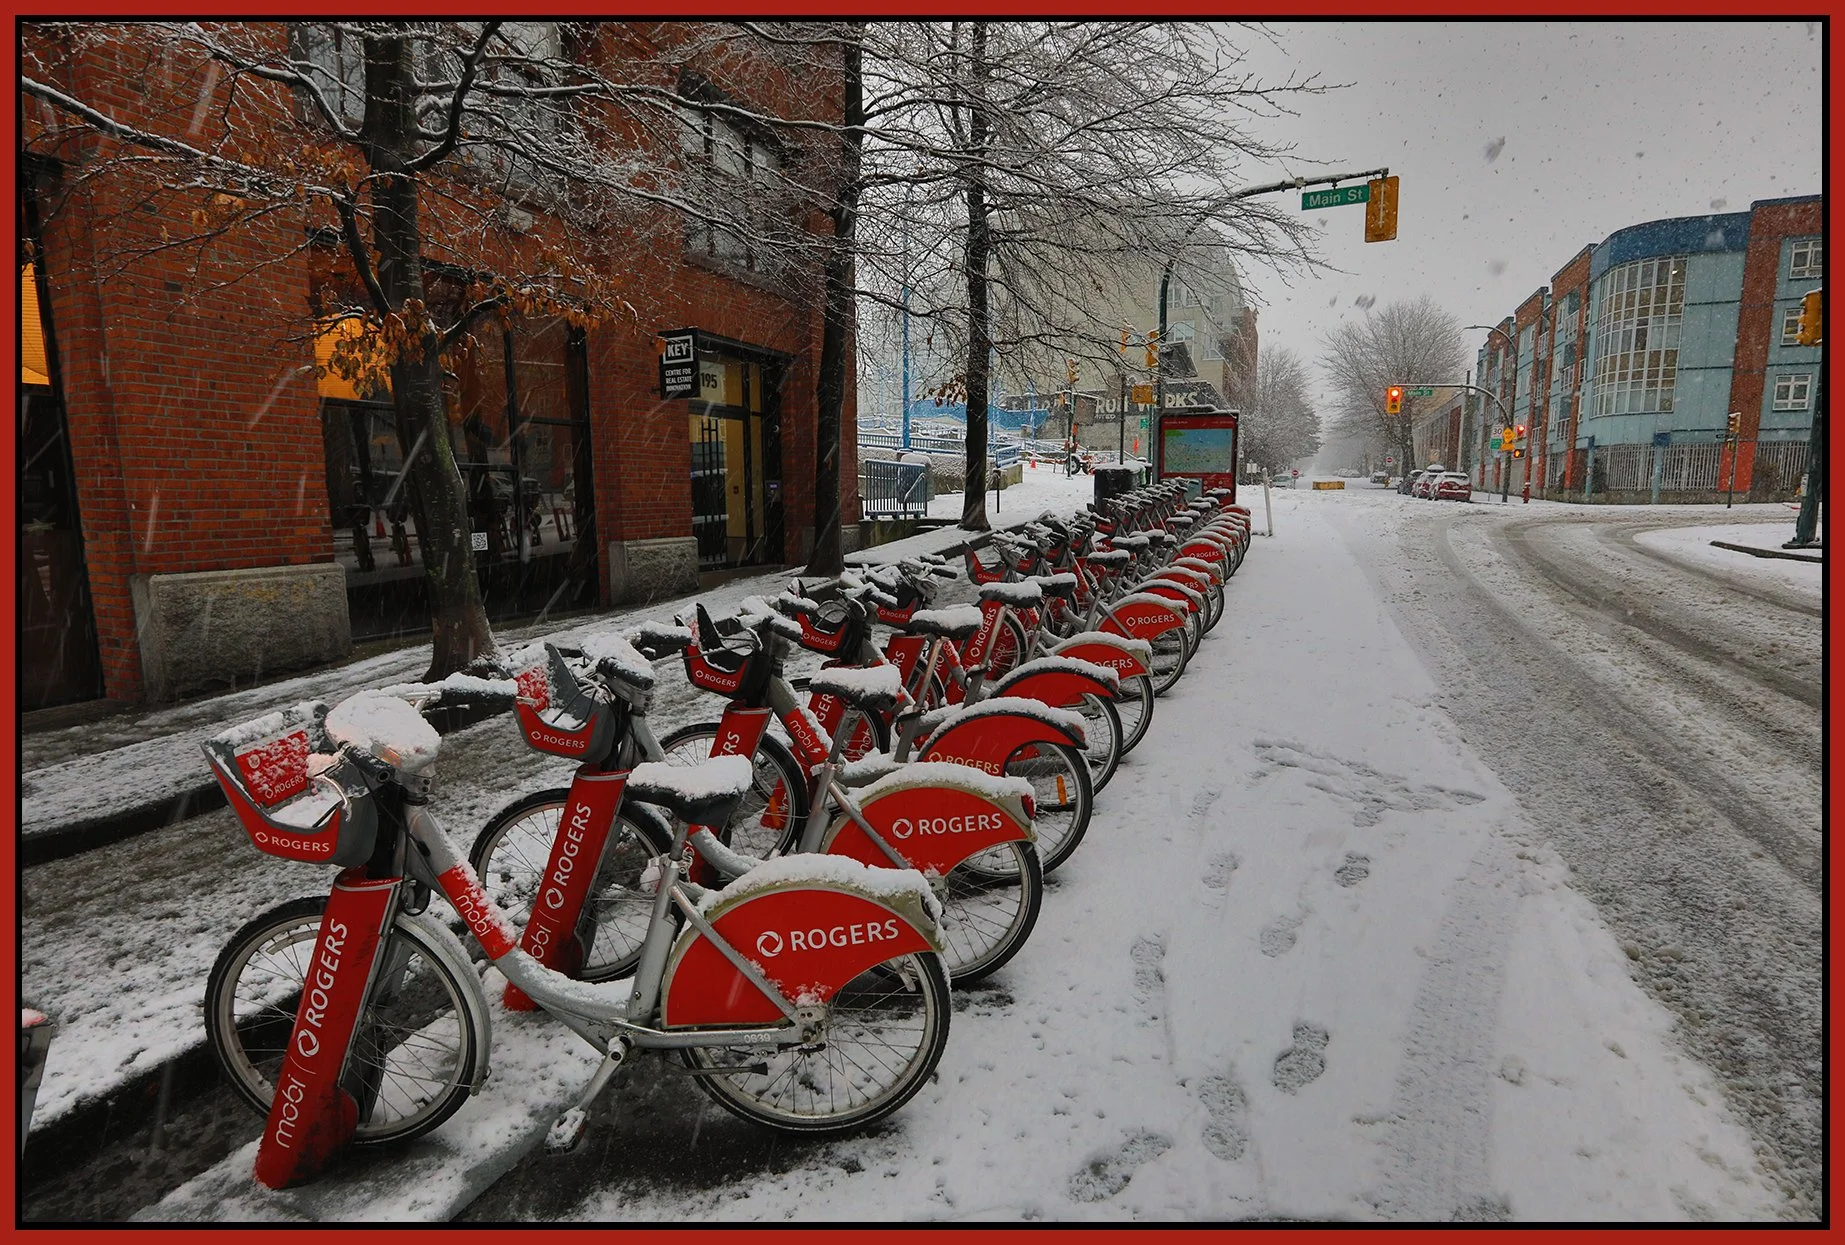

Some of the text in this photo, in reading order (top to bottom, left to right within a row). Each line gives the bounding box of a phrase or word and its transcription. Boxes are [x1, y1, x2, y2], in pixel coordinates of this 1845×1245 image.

[1309, 189, 1363, 207] Main St
[667, 342, 688, 357] KEY
[665, 367, 692, 376] CENTRE FOR
[700, 372, 718, 388] 195
[1184, 581, 1199, 589] ERS
[886, 610, 909, 620] ROGERS
[1137, 614, 1175, 625] ROGERS
[974, 607, 997, 648] ROGERS
[810, 635, 837, 647] ROGERS
[1094, 658, 1133, 670] OGERS
[704, 673, 737, 688] ROGERS
[543, 735, 585, 749] ROGERS
[790, 719, 813, 749] mobi
[274, 774, 305, 794] ROGERS
[918, 813, 1003, 836] ROGERS
[271, 836, 330, 853] ROGERS
[552, 802, 592, 887] ROGERS
[455, 895, 494, 937] mobi
[531, 922, 552, 960] obi
[790, 919, 900, 952] ROGERS
[305, 918, 348, 1028] ROGERS
[275, 1074, 306, 1149] mobi
